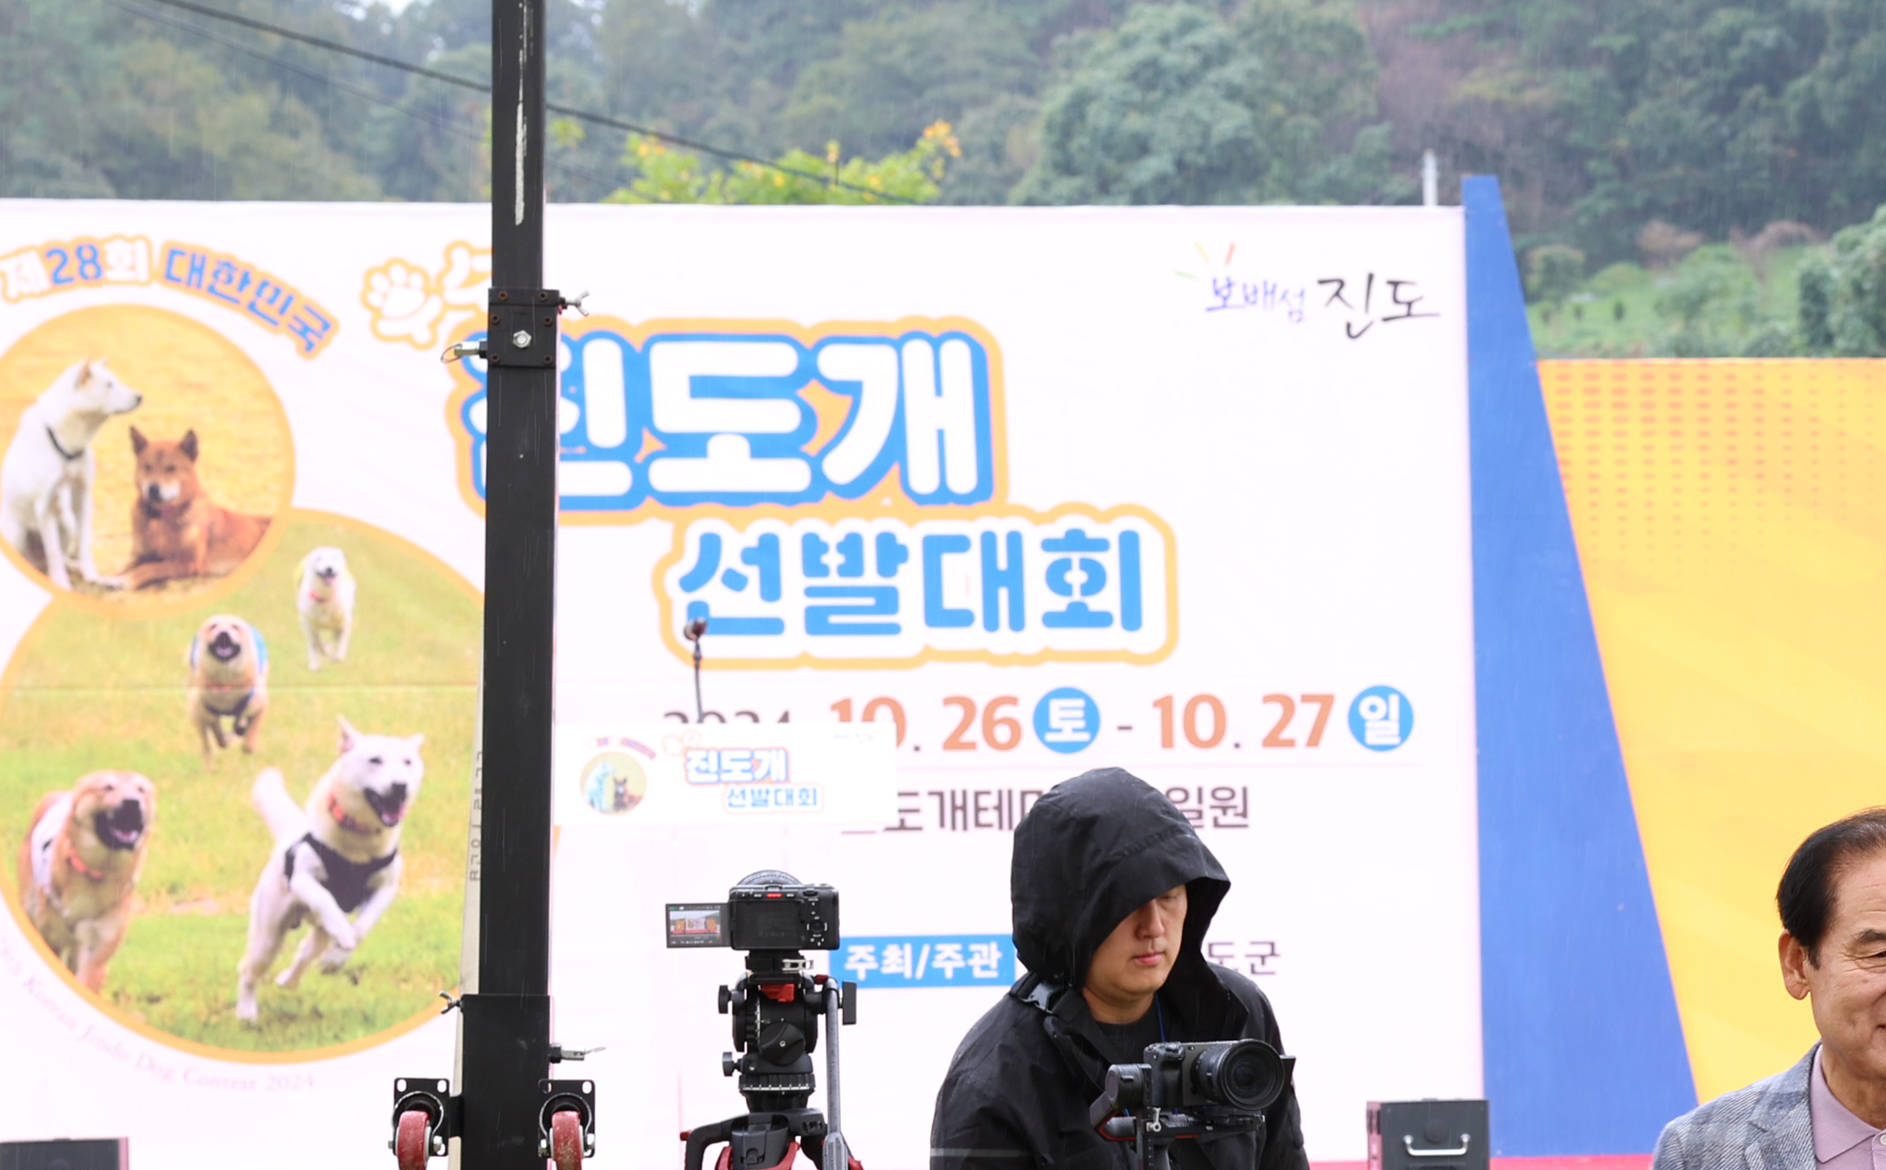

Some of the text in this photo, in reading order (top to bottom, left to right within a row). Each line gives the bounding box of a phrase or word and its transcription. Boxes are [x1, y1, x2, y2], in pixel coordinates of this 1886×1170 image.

[0, 238, 332, 353] 제28회 대한민국
[1205, 271, 1442, 340] 보배섬 진도
[677, 527, 1144, 637] 선발대회
[942, 695, 1022, 752] 26
[1152, 693, 1242, 750] 10.
[1261, 693, 1335, 749] 27
[684, 747, 790, 785] 진도개
[726, 786, 818, 808] 선발대회
[843, 940, 1003, 981] 주최/주관
